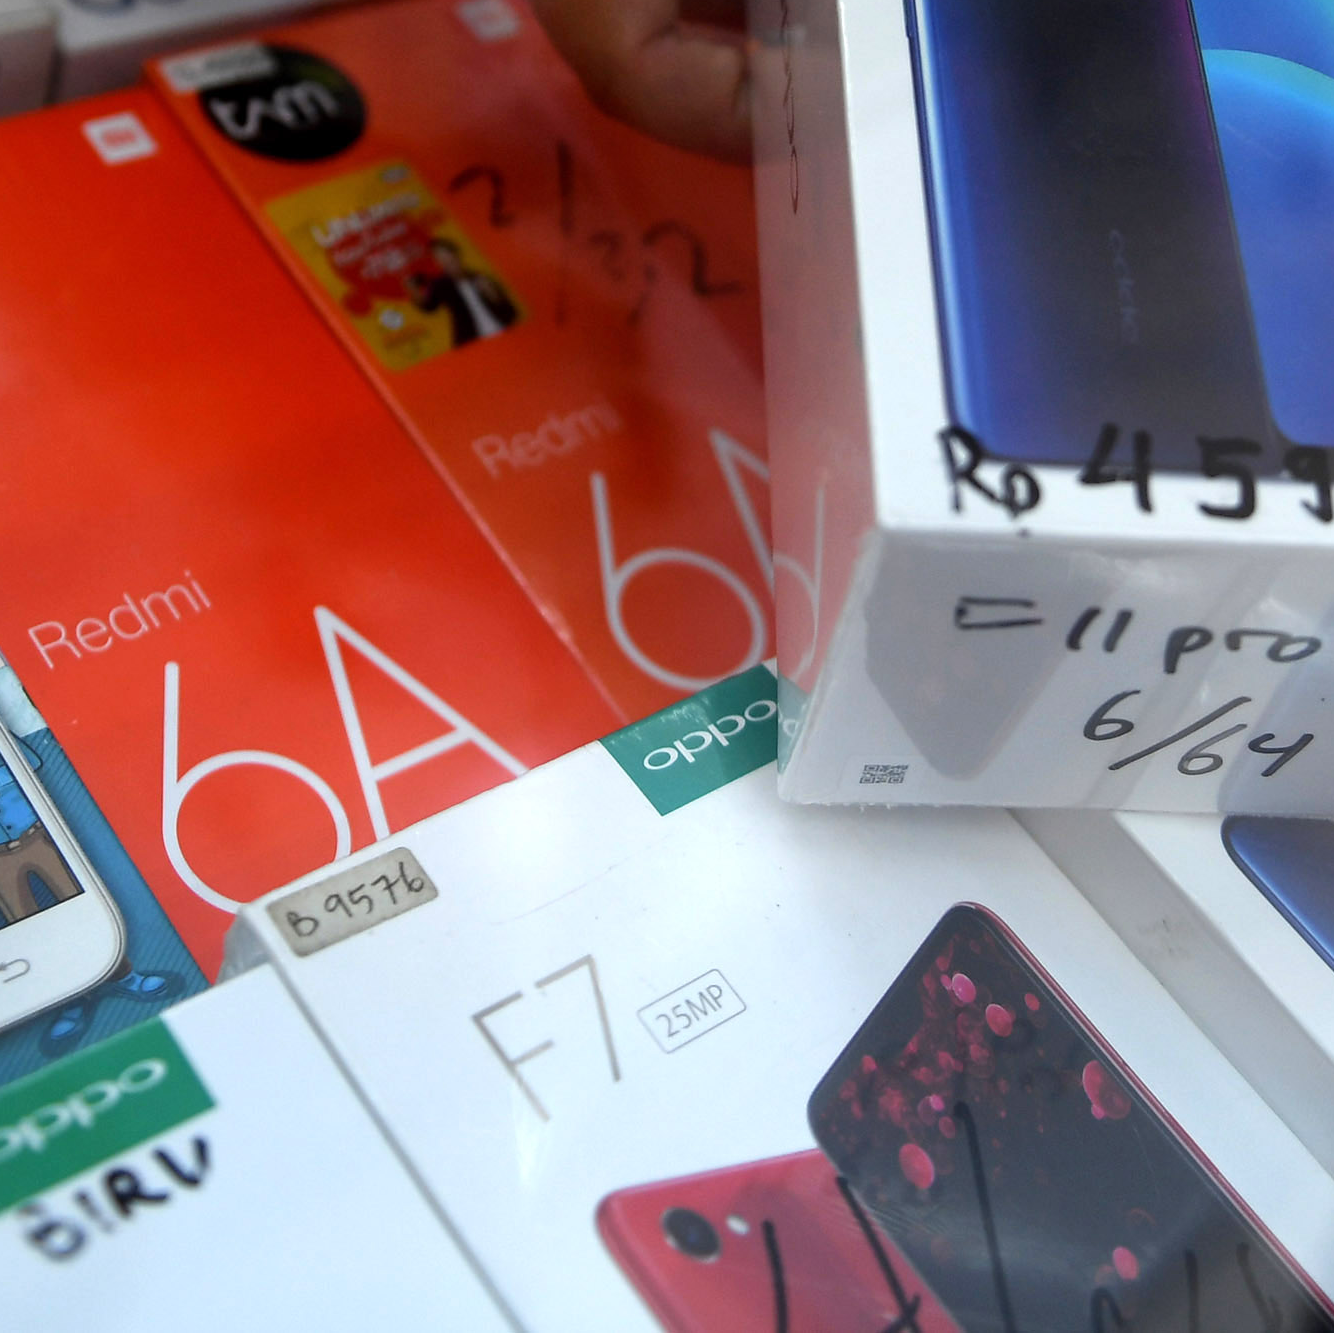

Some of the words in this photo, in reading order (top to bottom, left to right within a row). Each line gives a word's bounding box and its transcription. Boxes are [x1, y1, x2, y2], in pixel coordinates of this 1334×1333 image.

[472, 401, 621, 479] Redmi
[28, 569, 214, 669] Redmi
[1163, 625, 1323, 675] pro
[161, 605, 531, 916] 6A
[642, 699, 779, 771] oppo
[1082, 689, 1315, 778] 6/64
[324, 861, 425, 920] 9576
[471, 954, 621, 1123] F7
[654, 982, 727, 1038] 25MP
